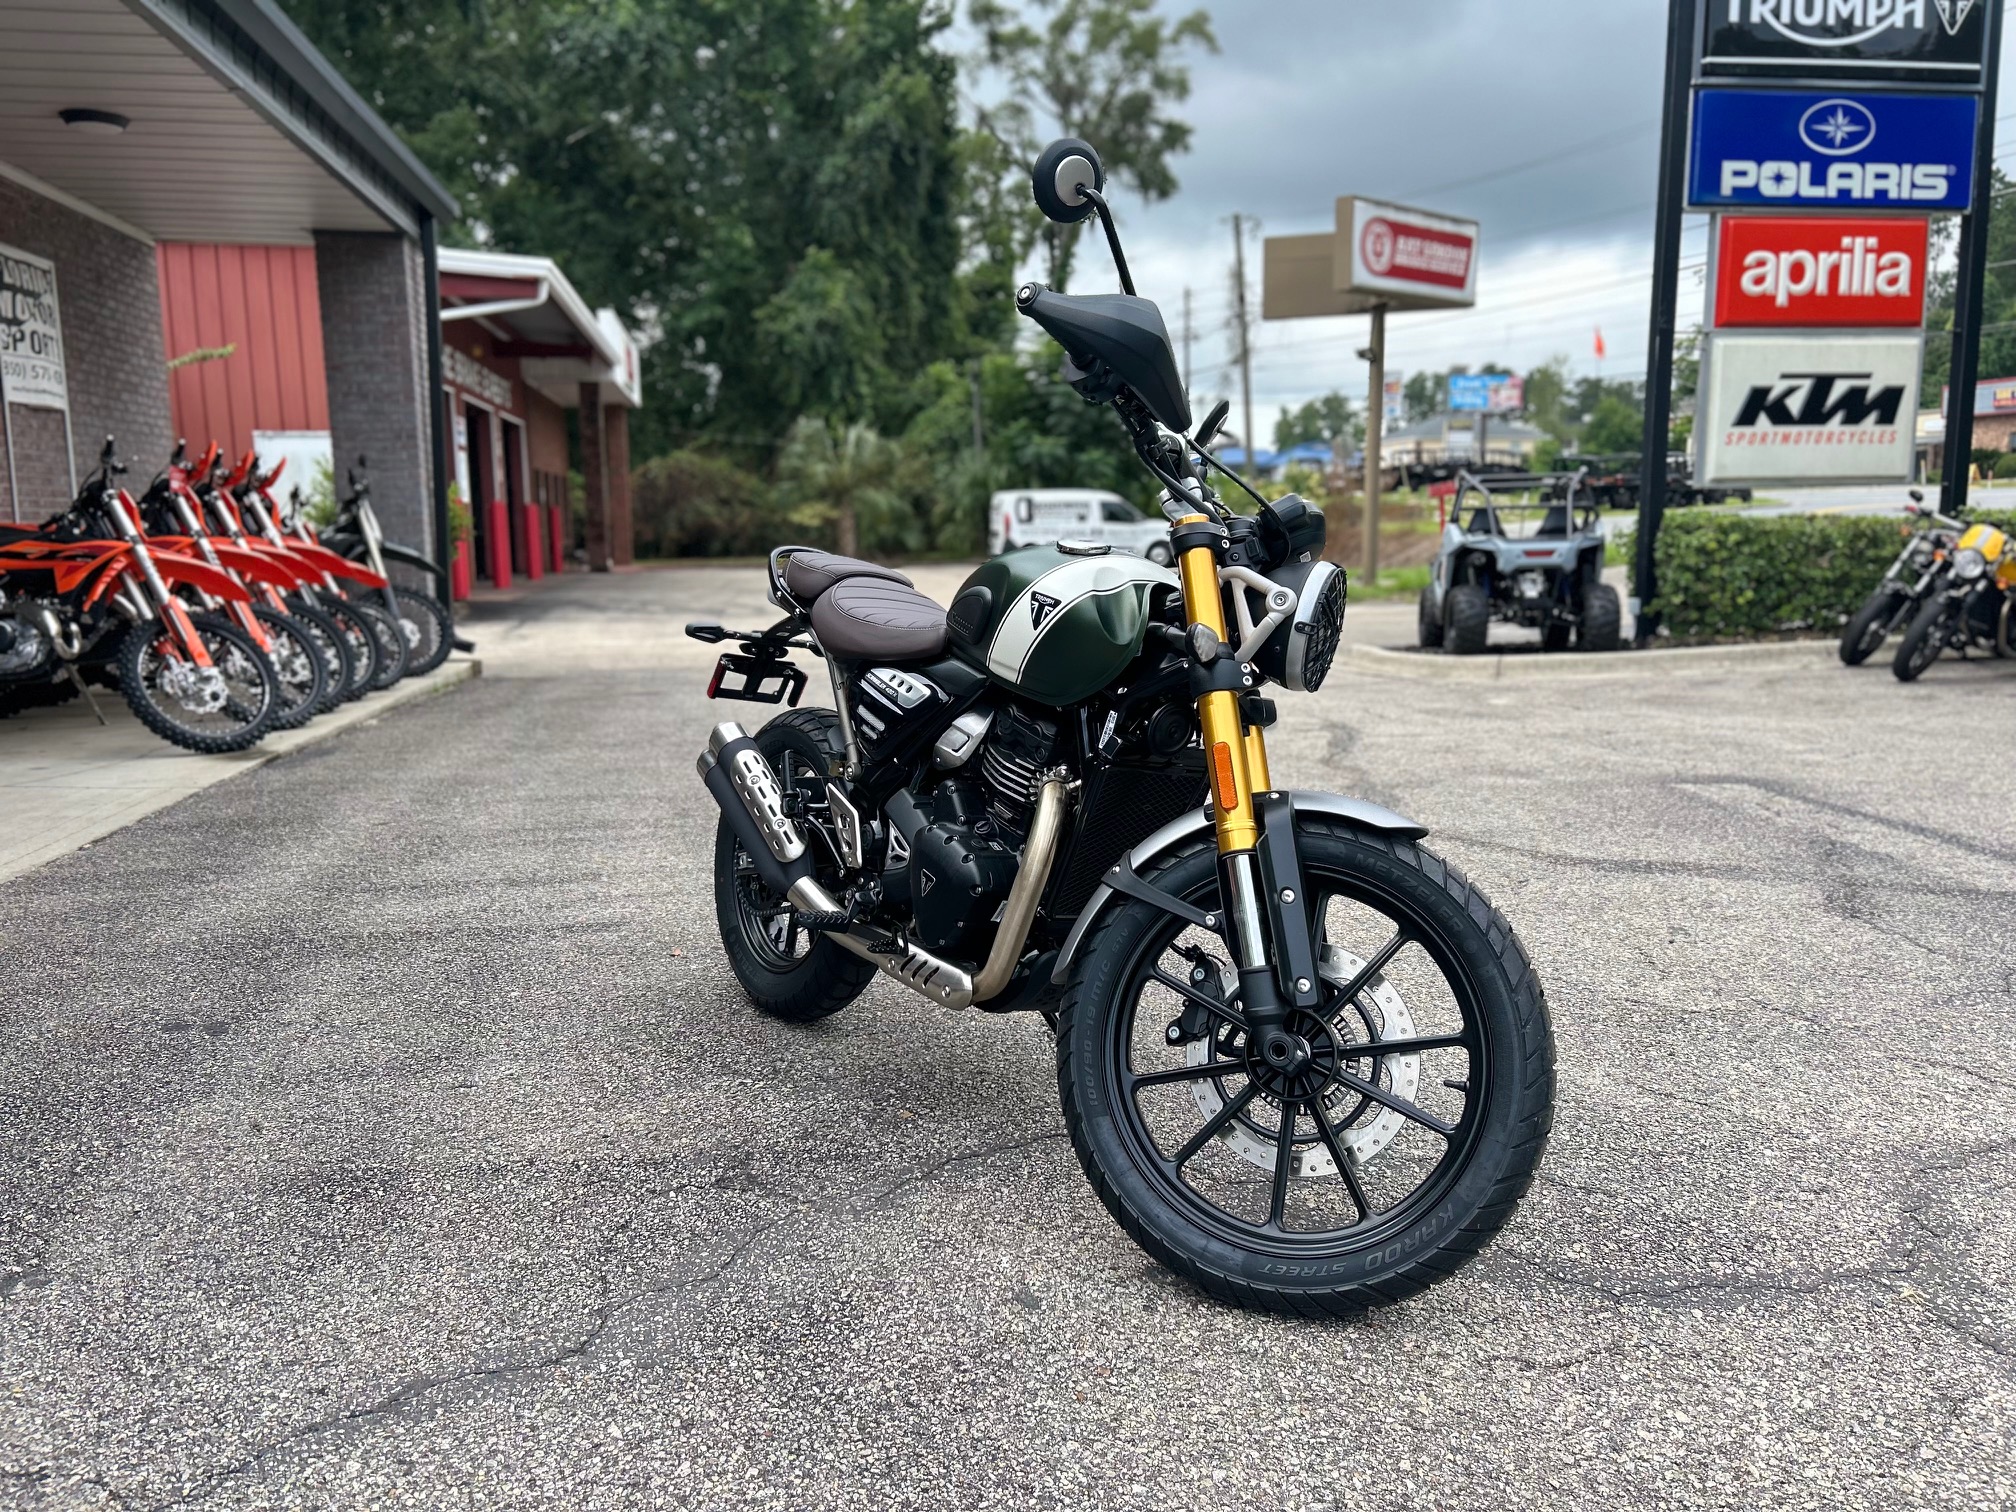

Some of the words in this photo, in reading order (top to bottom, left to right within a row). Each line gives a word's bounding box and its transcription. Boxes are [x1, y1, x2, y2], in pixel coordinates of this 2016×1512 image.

[1727, 0, 1925, 42] TRIUMPH
[1720, 160, 1950, 200] POLARIS
[1740, 236, 1911, 307] aprilia
[1732, 373, 1906, 427] KTM
[1724, 430, 1898, 447] SPORTMOTORCYCLES
[1364, 1202, 1455, 1271] KAROO
[1257, 1261, 1347, 1276] STREET
